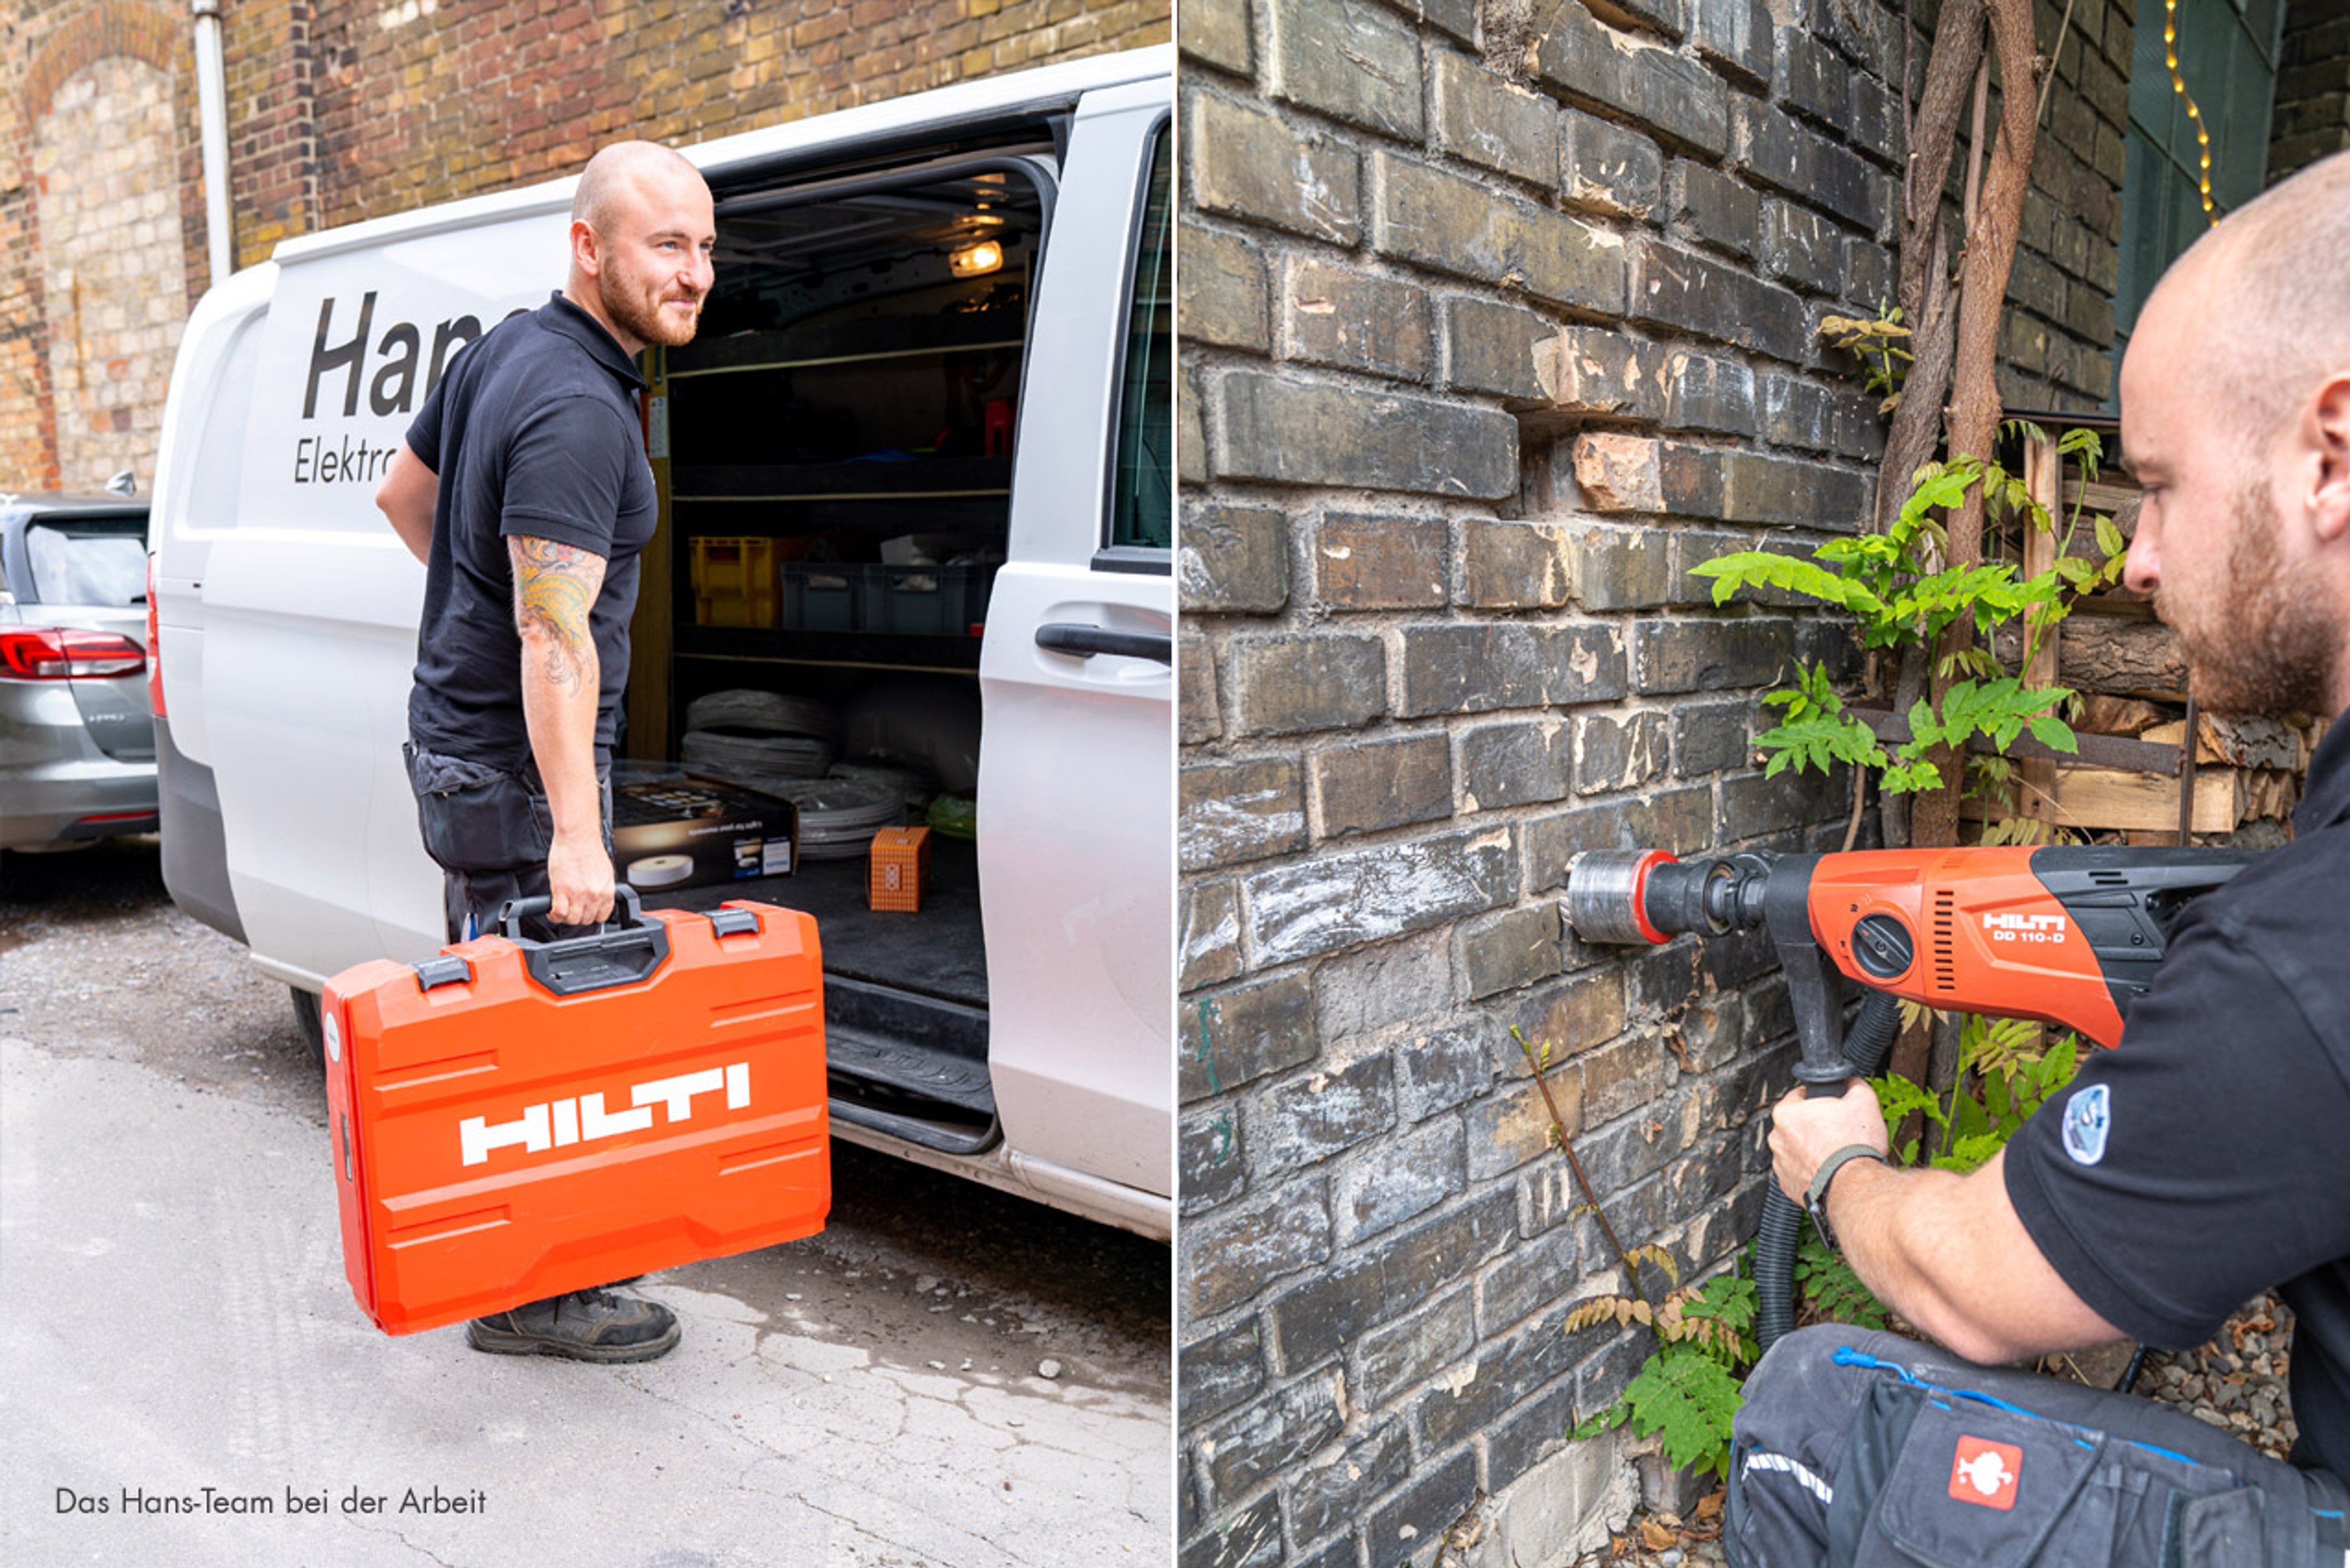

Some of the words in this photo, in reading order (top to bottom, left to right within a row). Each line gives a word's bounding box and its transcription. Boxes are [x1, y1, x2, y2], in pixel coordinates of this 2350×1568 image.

[302, 291, 530, 420] Han
[1983, 913, 2066, 931] HILTI
[1993, 930, 2016, 941] DD
[2020, 931, 2065, 943] 110-D
[459, 1062, 750, 1167] HILTI
